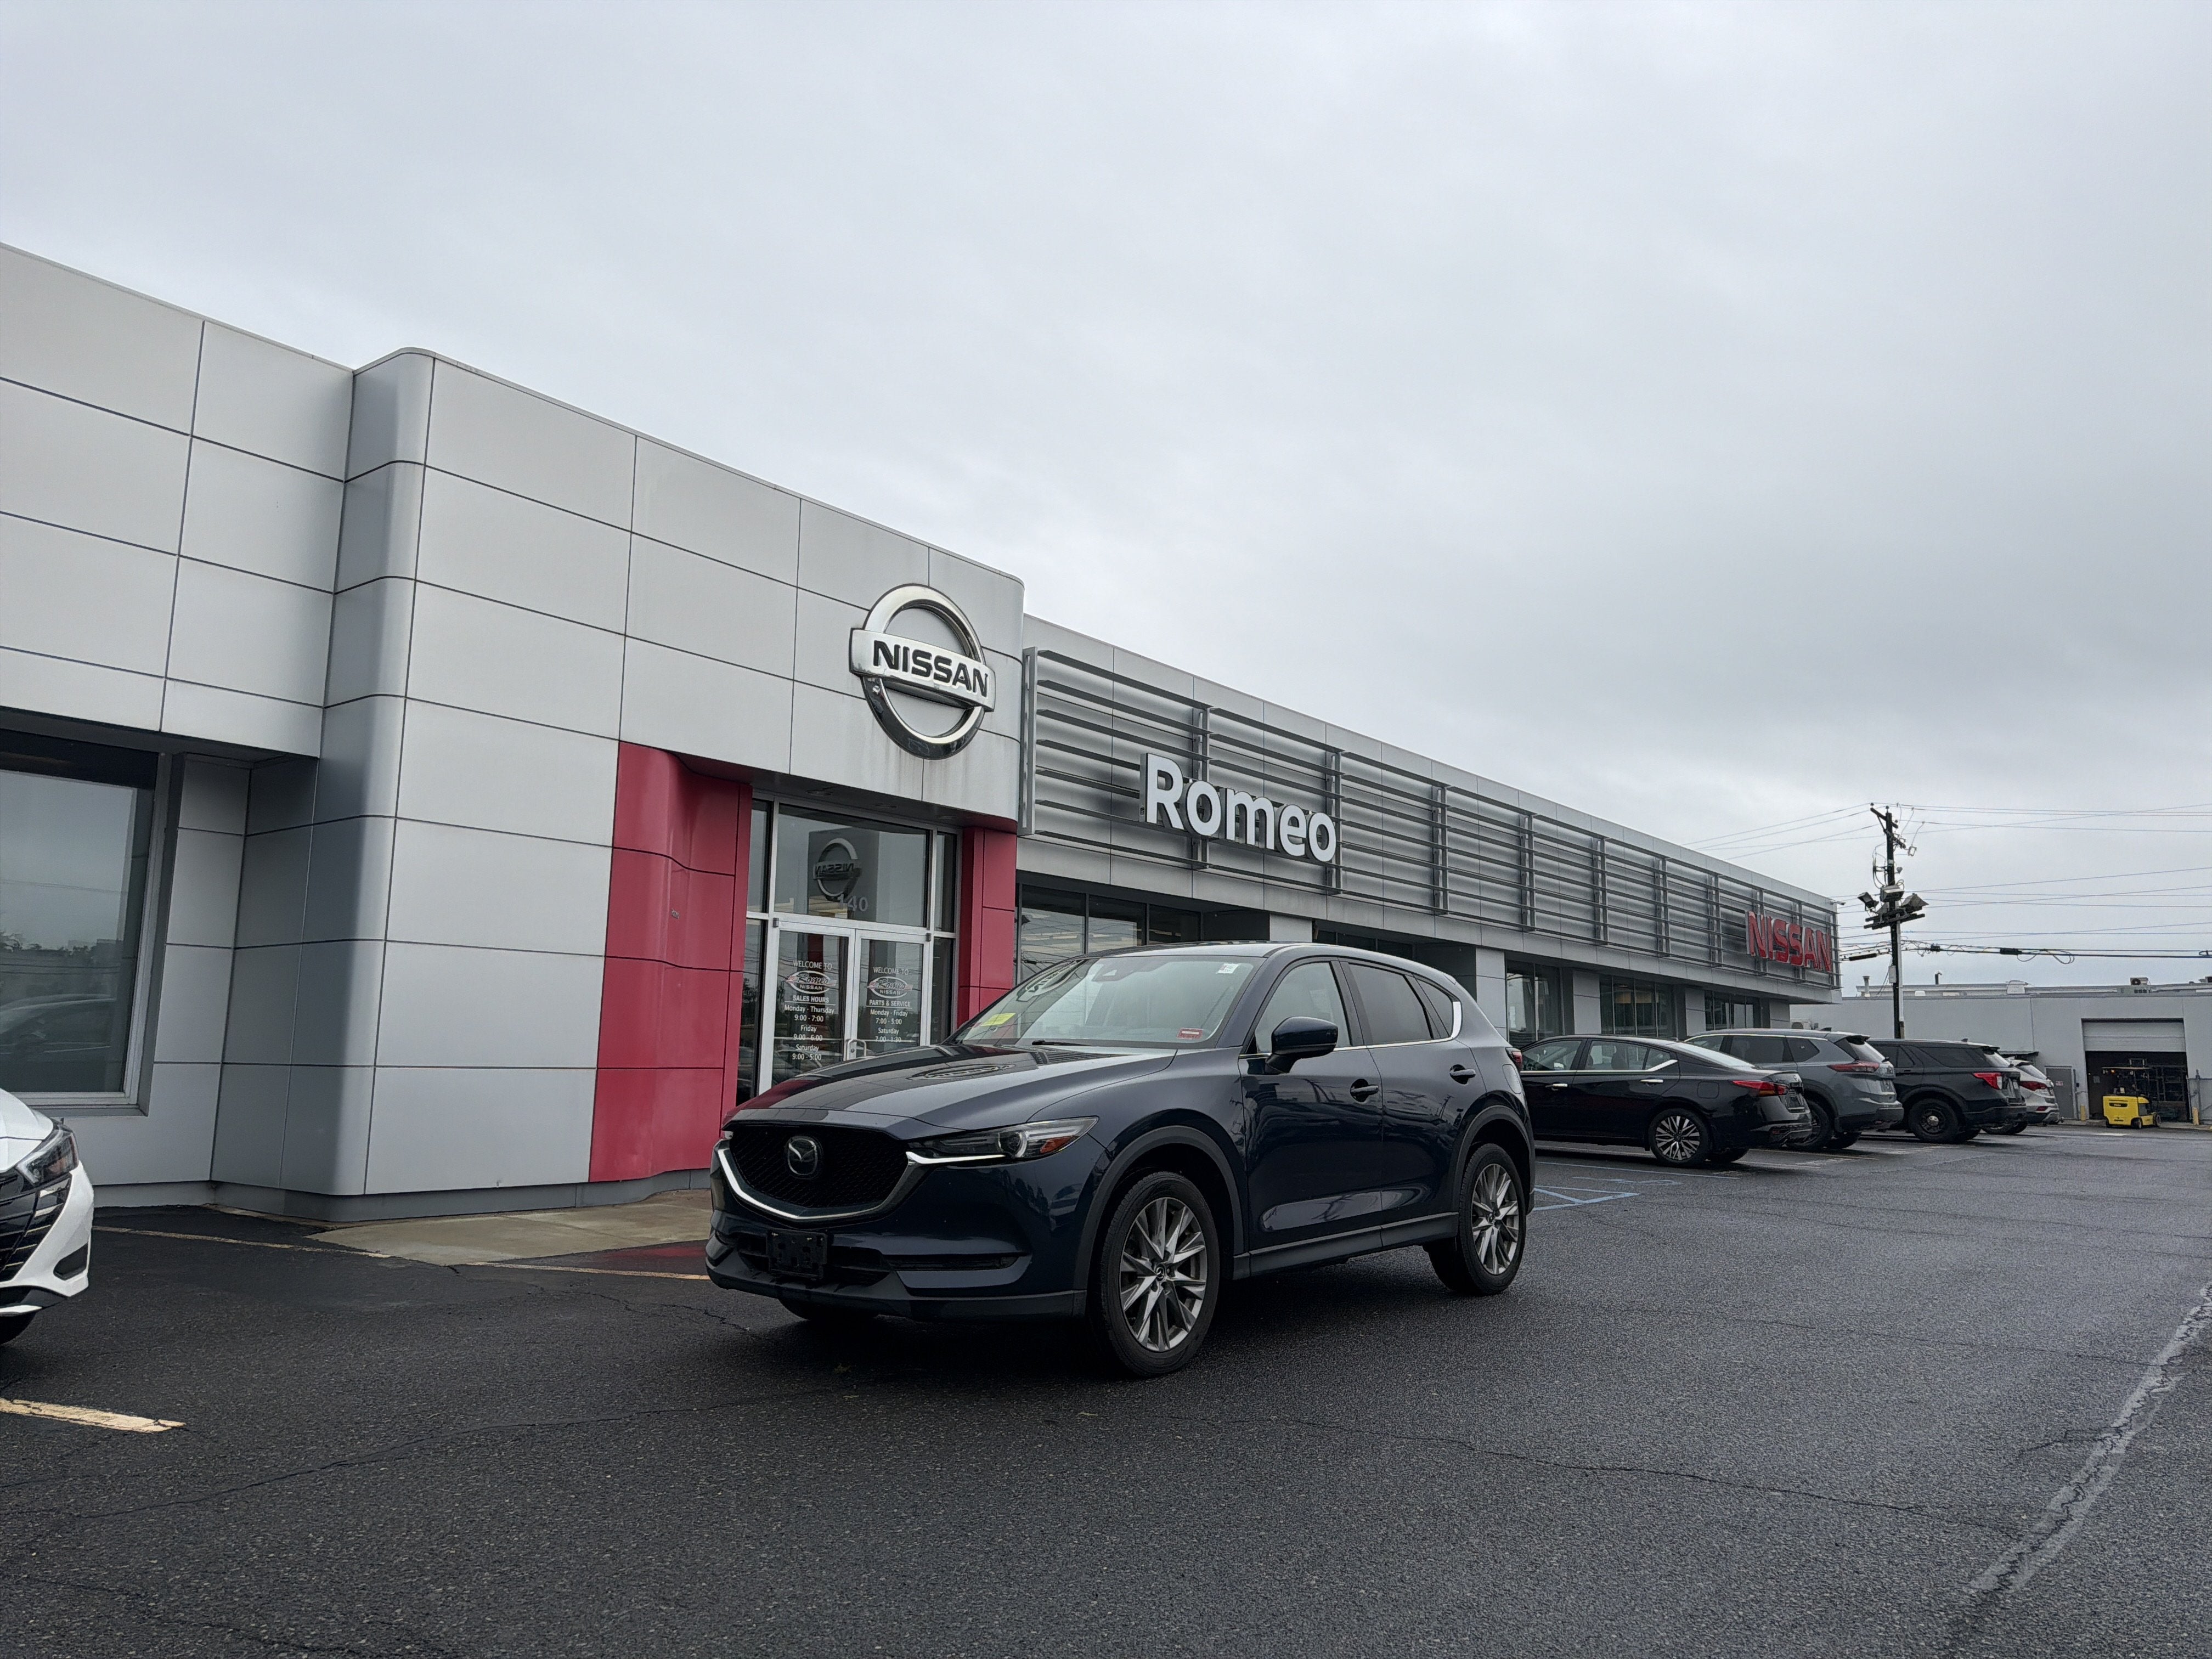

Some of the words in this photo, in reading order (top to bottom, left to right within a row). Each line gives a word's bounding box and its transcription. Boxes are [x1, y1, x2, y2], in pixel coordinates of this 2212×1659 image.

[873, 640, 988, 697] NISSAN
[1141, 752, 1336, 862] Romeo
[837, 894, 868, 912] 140
[1746, 911, 1832, 973] NISSAN
[793, 960, 822, 969] WELCOME
[824, 962, 832, 970] TO
[797, 972, 829, 984] Romeo
[877, 978, 906, 989] Romeo
[785, 1005, 806, 1013] Monday
[810, 1006, 834, 1014] Thursday
[870, 1009, 889, 1017] Monday
[795, 1044, 820, 1052] Saturday
